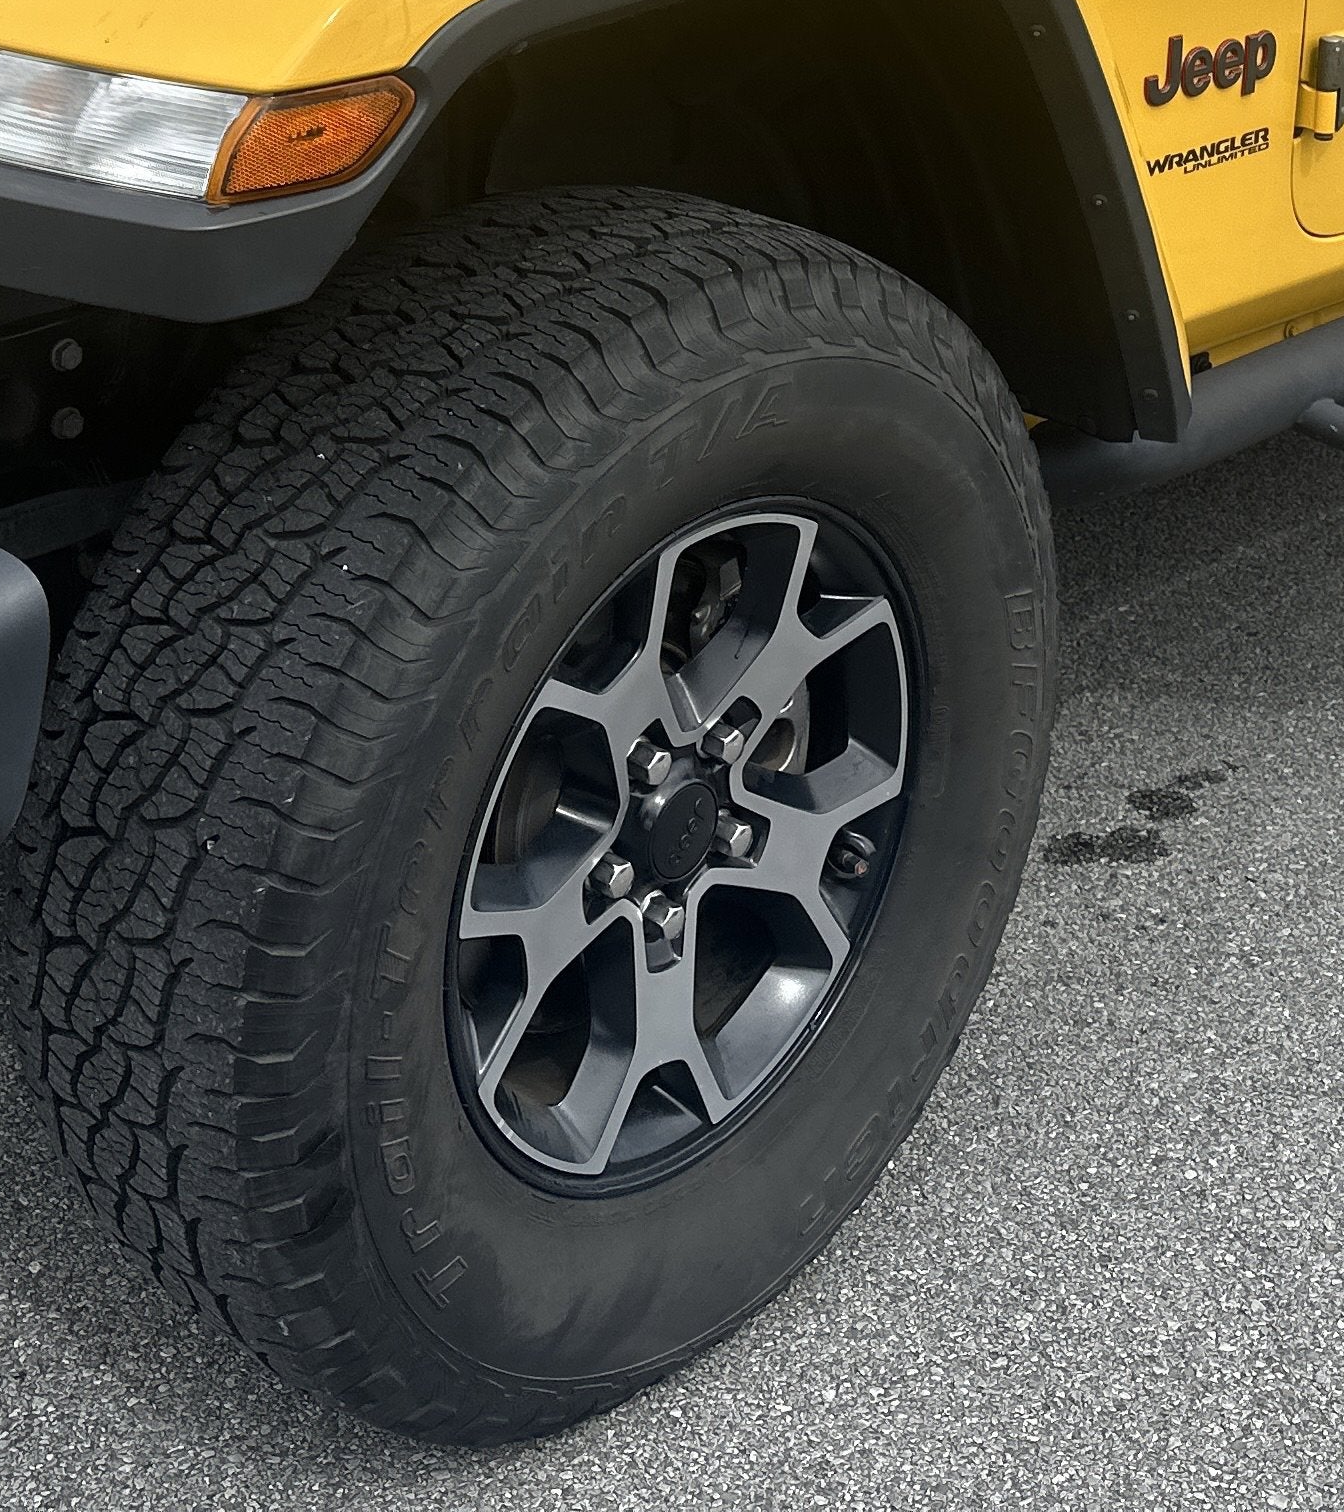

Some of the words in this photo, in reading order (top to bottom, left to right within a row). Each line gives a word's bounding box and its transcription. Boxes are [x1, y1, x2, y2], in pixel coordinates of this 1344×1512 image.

[1143, 29, 1277, 107] Jeep
[1146, 127, 1269, 176] WRANGLER
[1183, 142, 1269, 175] UNLIMITED
